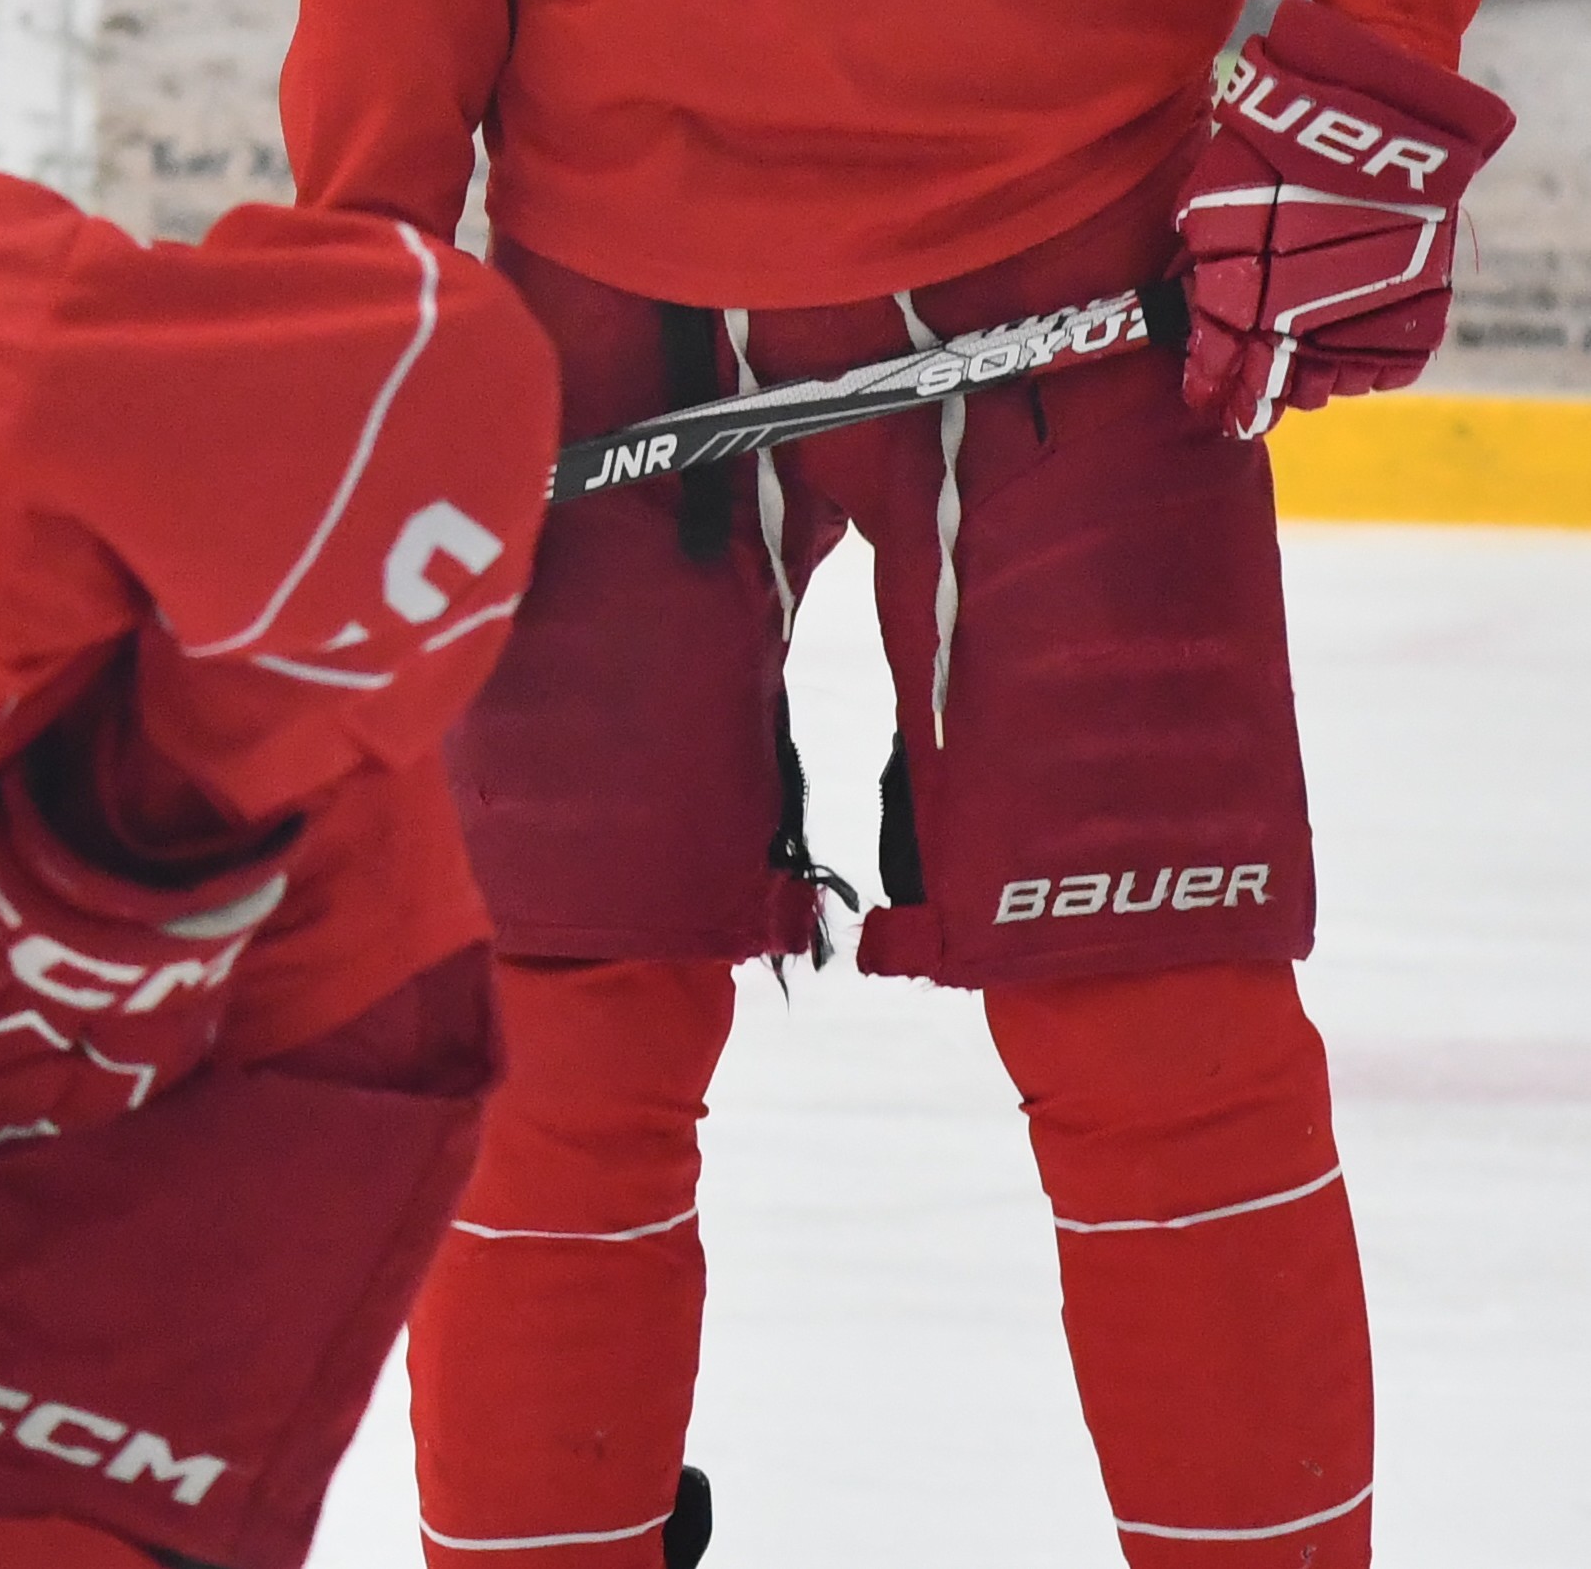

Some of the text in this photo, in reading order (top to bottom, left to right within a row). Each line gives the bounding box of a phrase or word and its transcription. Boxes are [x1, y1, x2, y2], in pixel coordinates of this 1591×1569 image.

[1212, 51, 1449, 193] AUER
[584, 433, 678, 501] JNR
[992, 862, 1271, 925] BAUER
